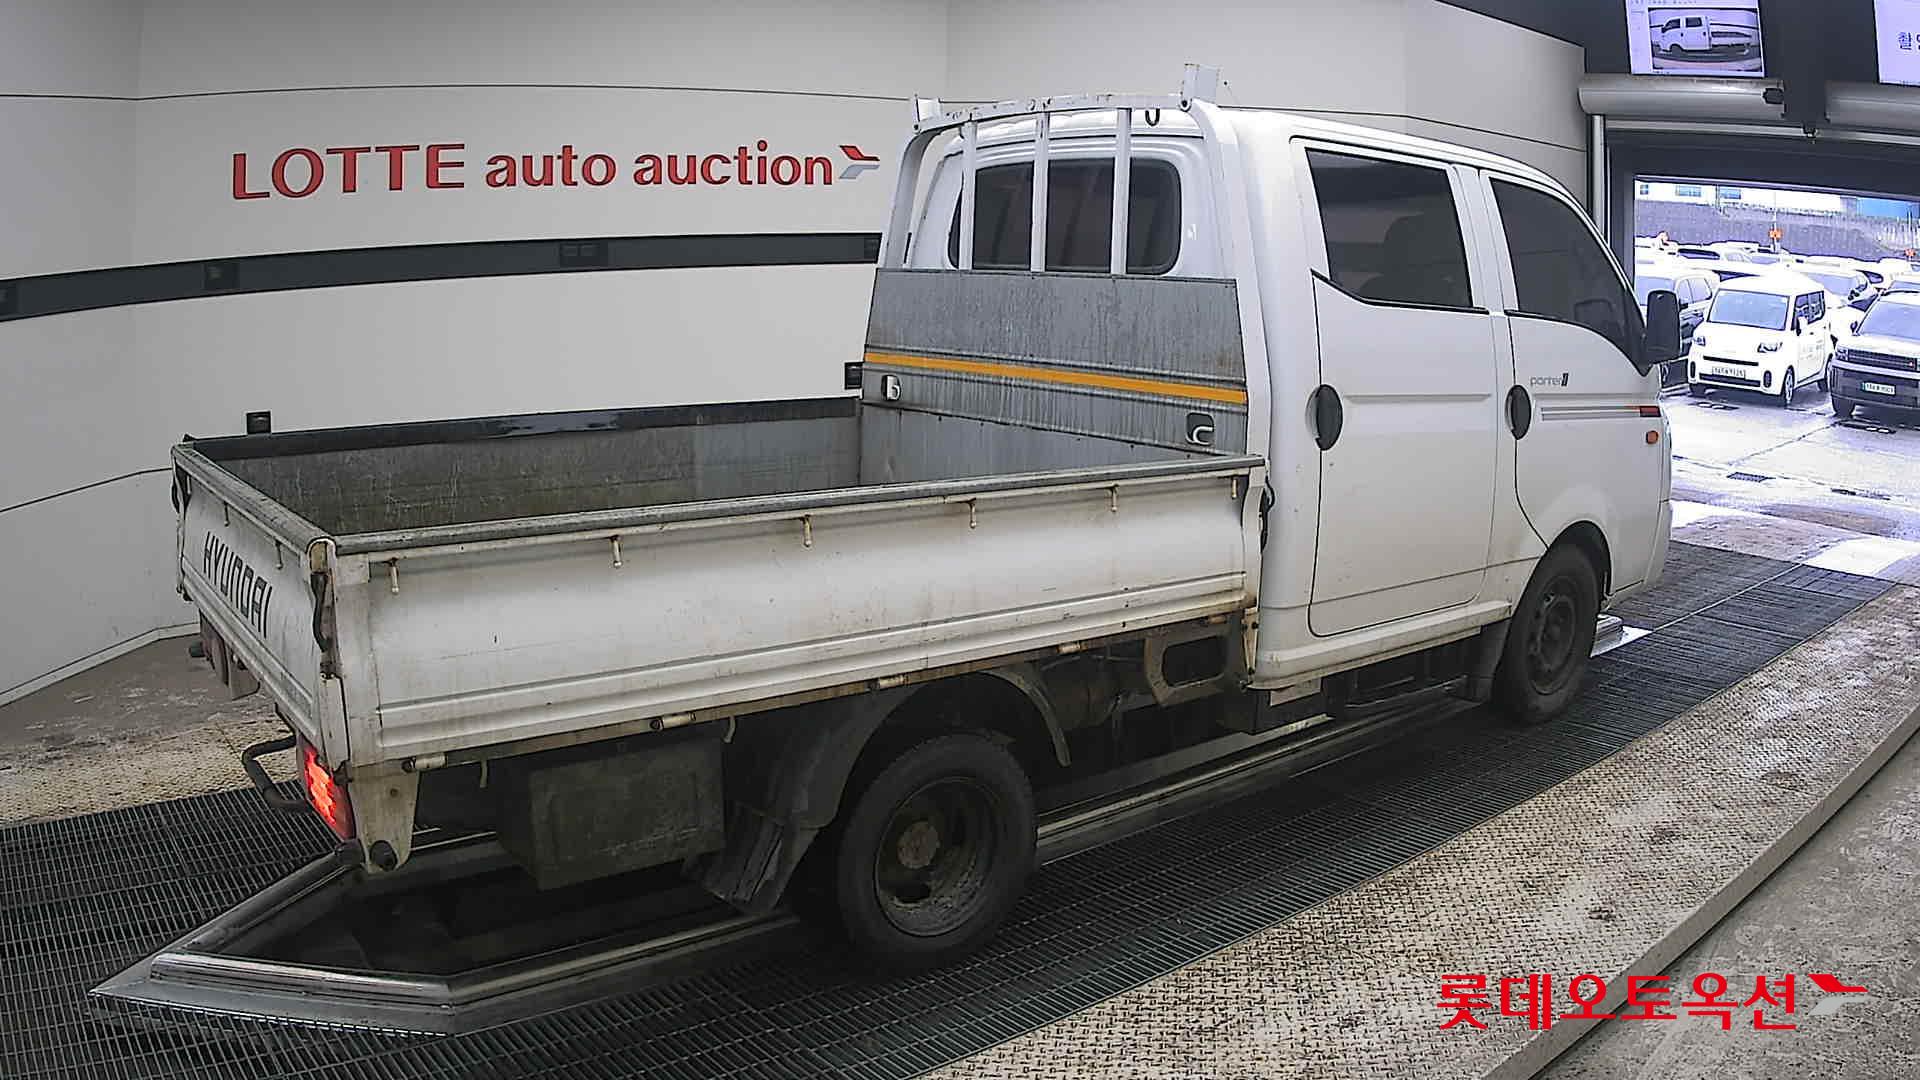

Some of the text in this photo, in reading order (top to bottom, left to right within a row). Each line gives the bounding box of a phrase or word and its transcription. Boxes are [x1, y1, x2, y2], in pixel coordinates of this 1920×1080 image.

[232, 140, 833, 200] LOTTE auto auction
[203, 531, 273, 639] HYUNDAI
